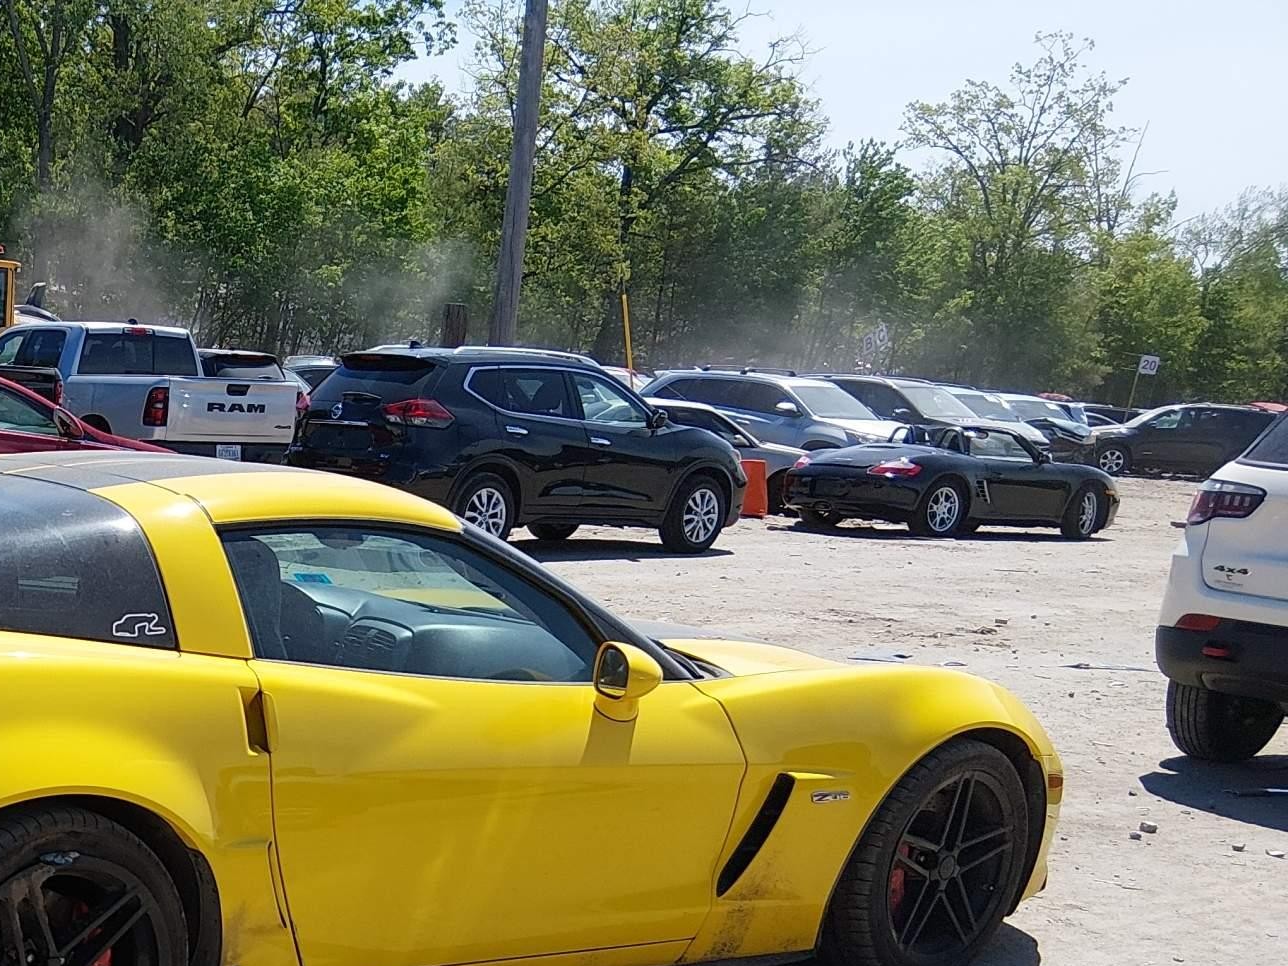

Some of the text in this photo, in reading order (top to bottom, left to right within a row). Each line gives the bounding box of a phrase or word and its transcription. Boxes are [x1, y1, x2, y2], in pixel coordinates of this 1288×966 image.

[1142, 359, 1157, 371] 20
[207, 402, 266, 414] RAM
[1214, 565, 1249, 575] 4x4
